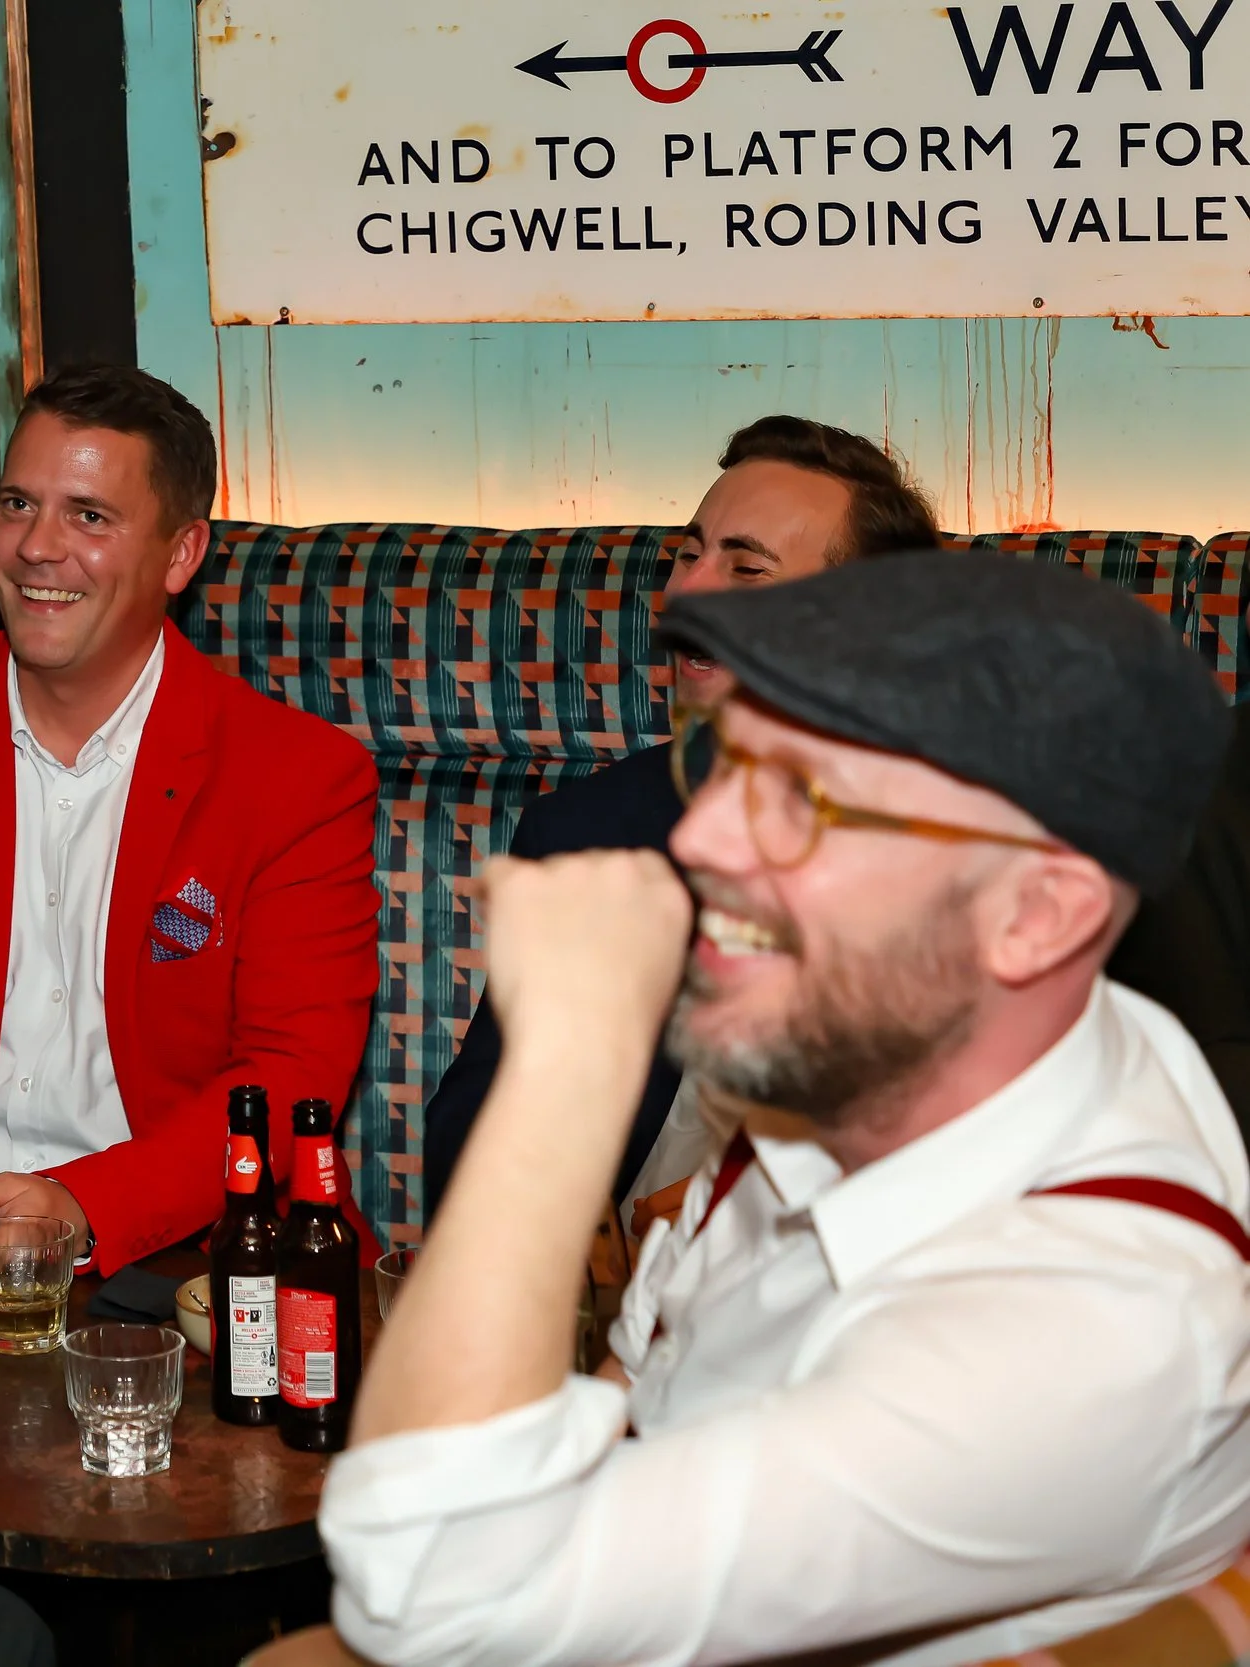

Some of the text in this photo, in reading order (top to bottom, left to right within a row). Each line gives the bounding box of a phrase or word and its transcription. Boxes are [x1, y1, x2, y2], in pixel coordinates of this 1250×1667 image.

[946, 0, 1233, 96] WAY
[358, 120, 1250, 185] AND TO PLATFORM 2 FOR
[357, 206, 686, 255] CHIGWELL,
[726, 200, 981, 247] RODING
